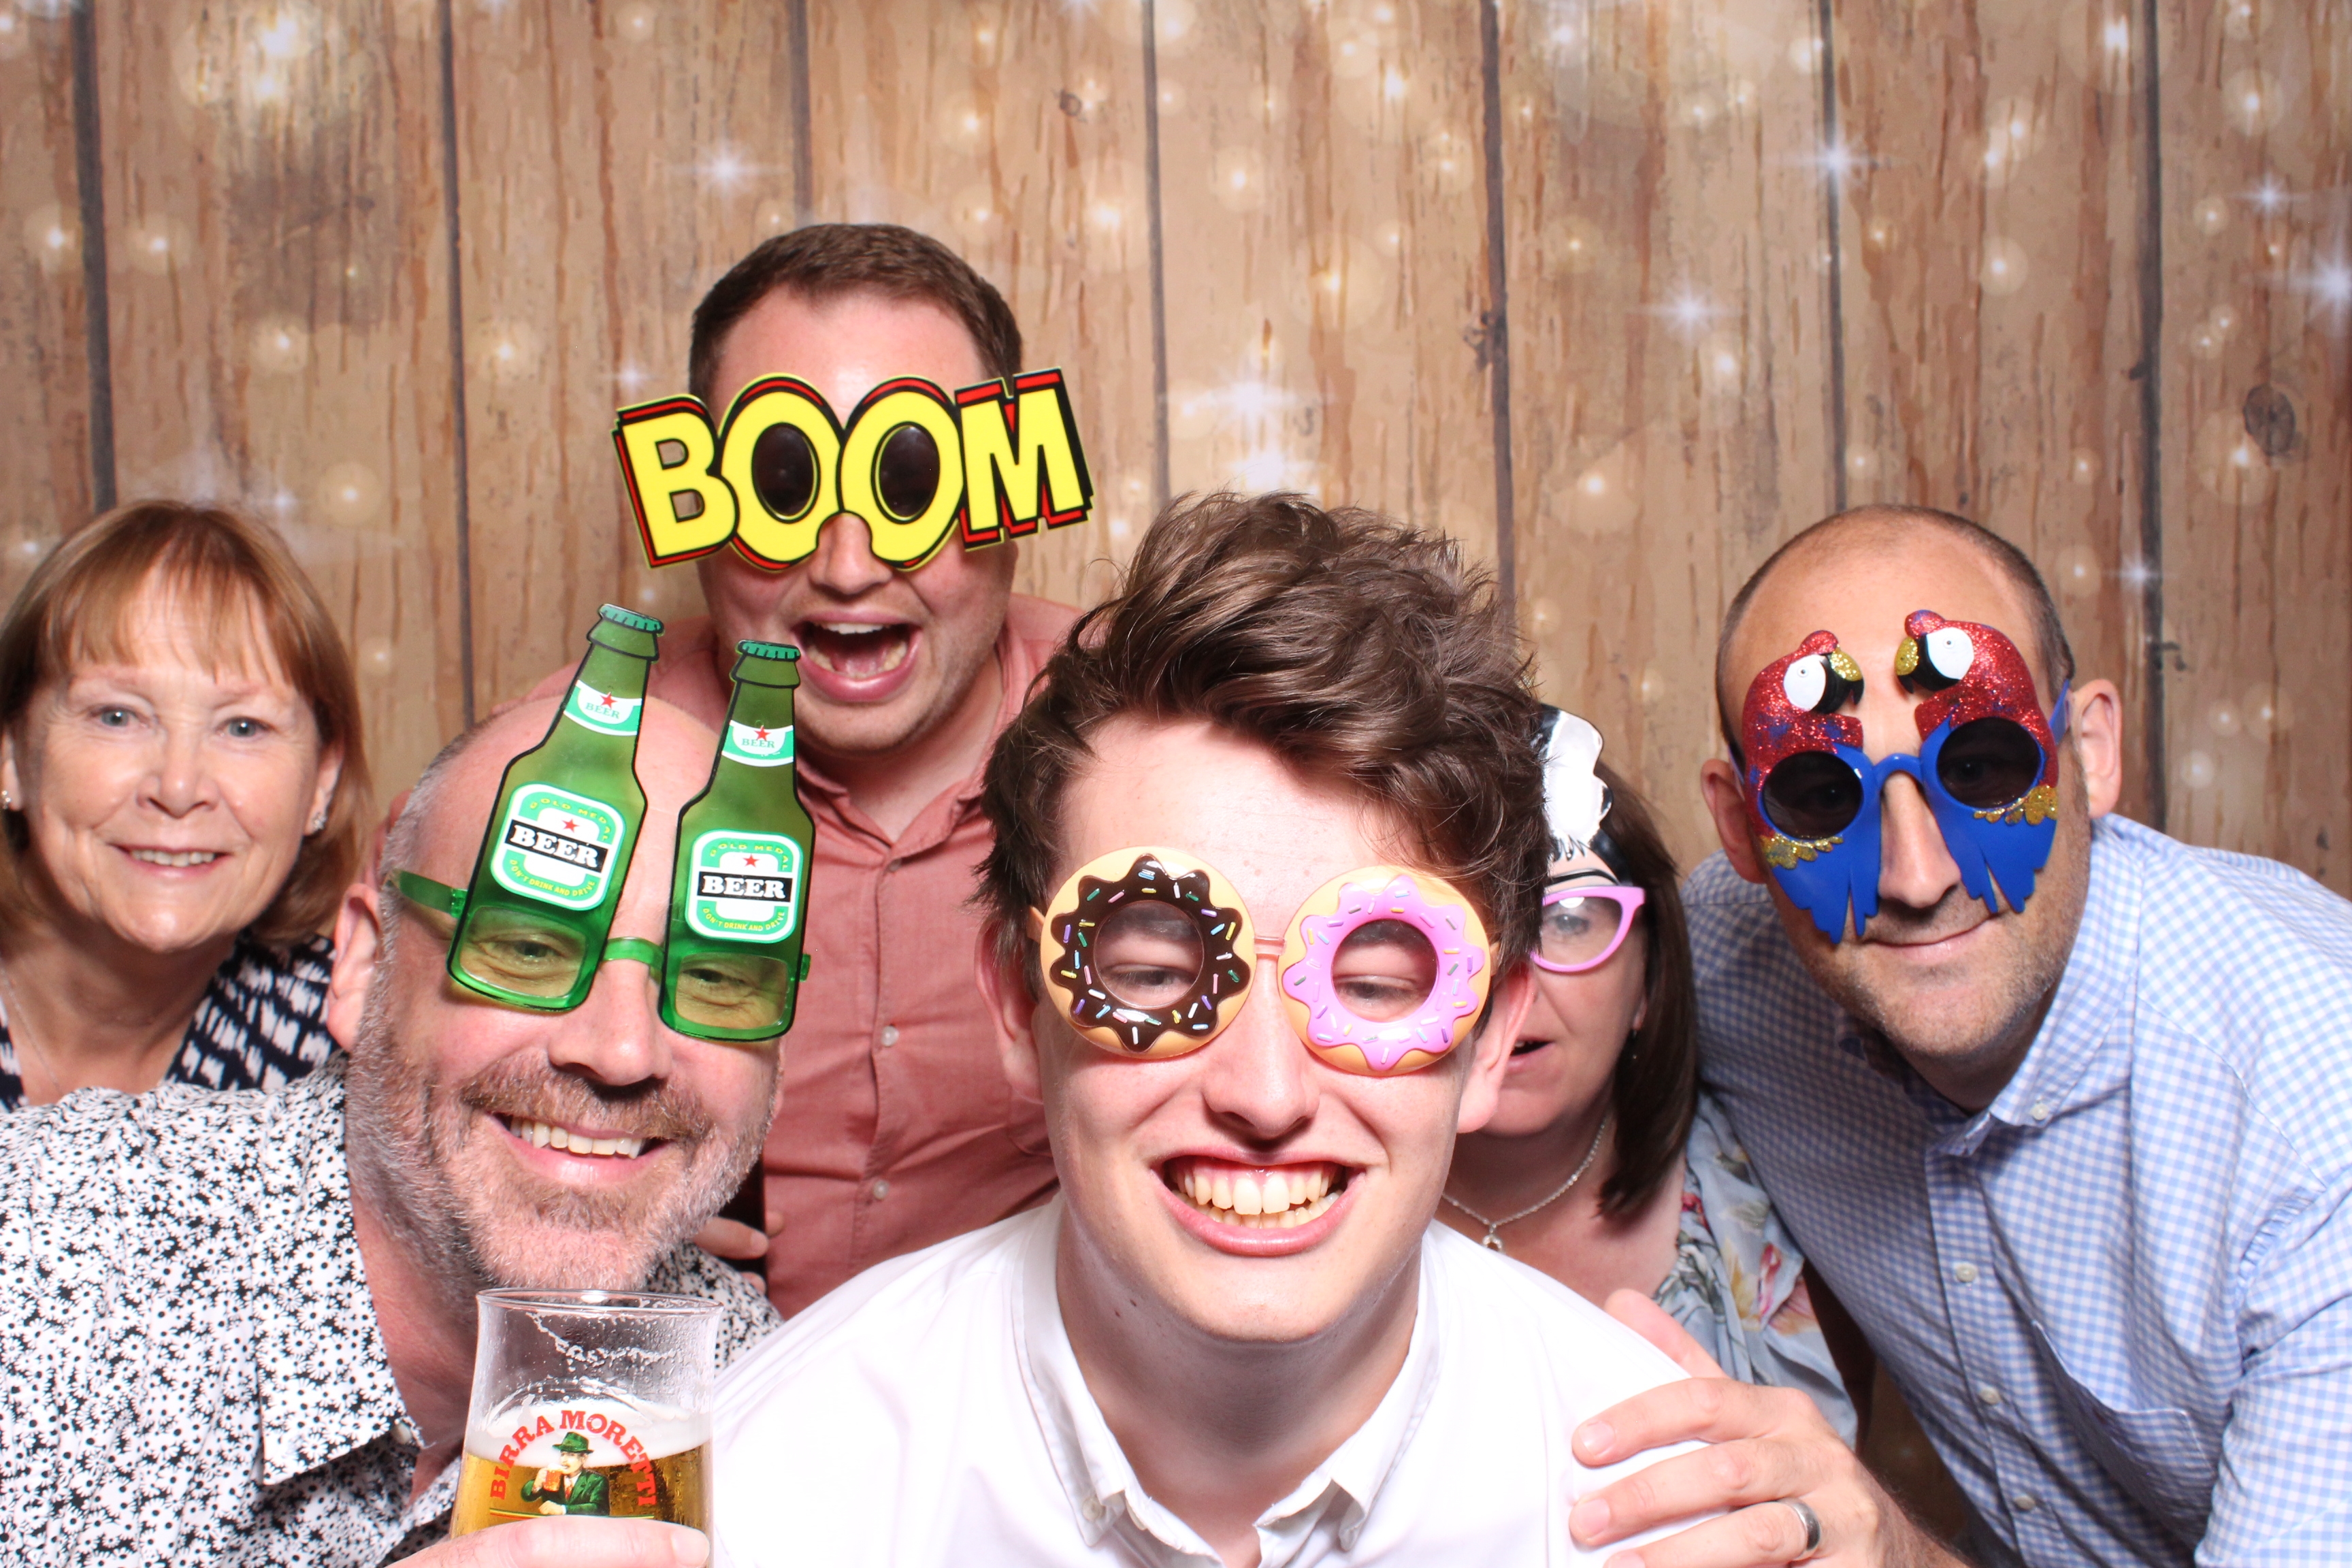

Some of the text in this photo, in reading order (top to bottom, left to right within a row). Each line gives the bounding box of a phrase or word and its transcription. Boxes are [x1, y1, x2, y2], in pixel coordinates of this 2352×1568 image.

[617, 373, 1090, 567] BOOM
[585, 702, 620, 719] BEER
[742, 738, 774, 749] BEER
[529, 798, 610, 841] GOLD MEDAL
[510, 824, 598, 868] BEER
[710, 843, 789, 870] GOLD MEDAL
[509, 859, 595, 897] DON'T DRINK AND DRIVE
[702, 875, 786, 899] BEER
[702, 908, 723, 927] DON'T
[723, 922, 747, 930] DRINK
[765, 912, 785, 930] DRIVE
[490, 1410, 657, 1505] BIRRA MORETTI
